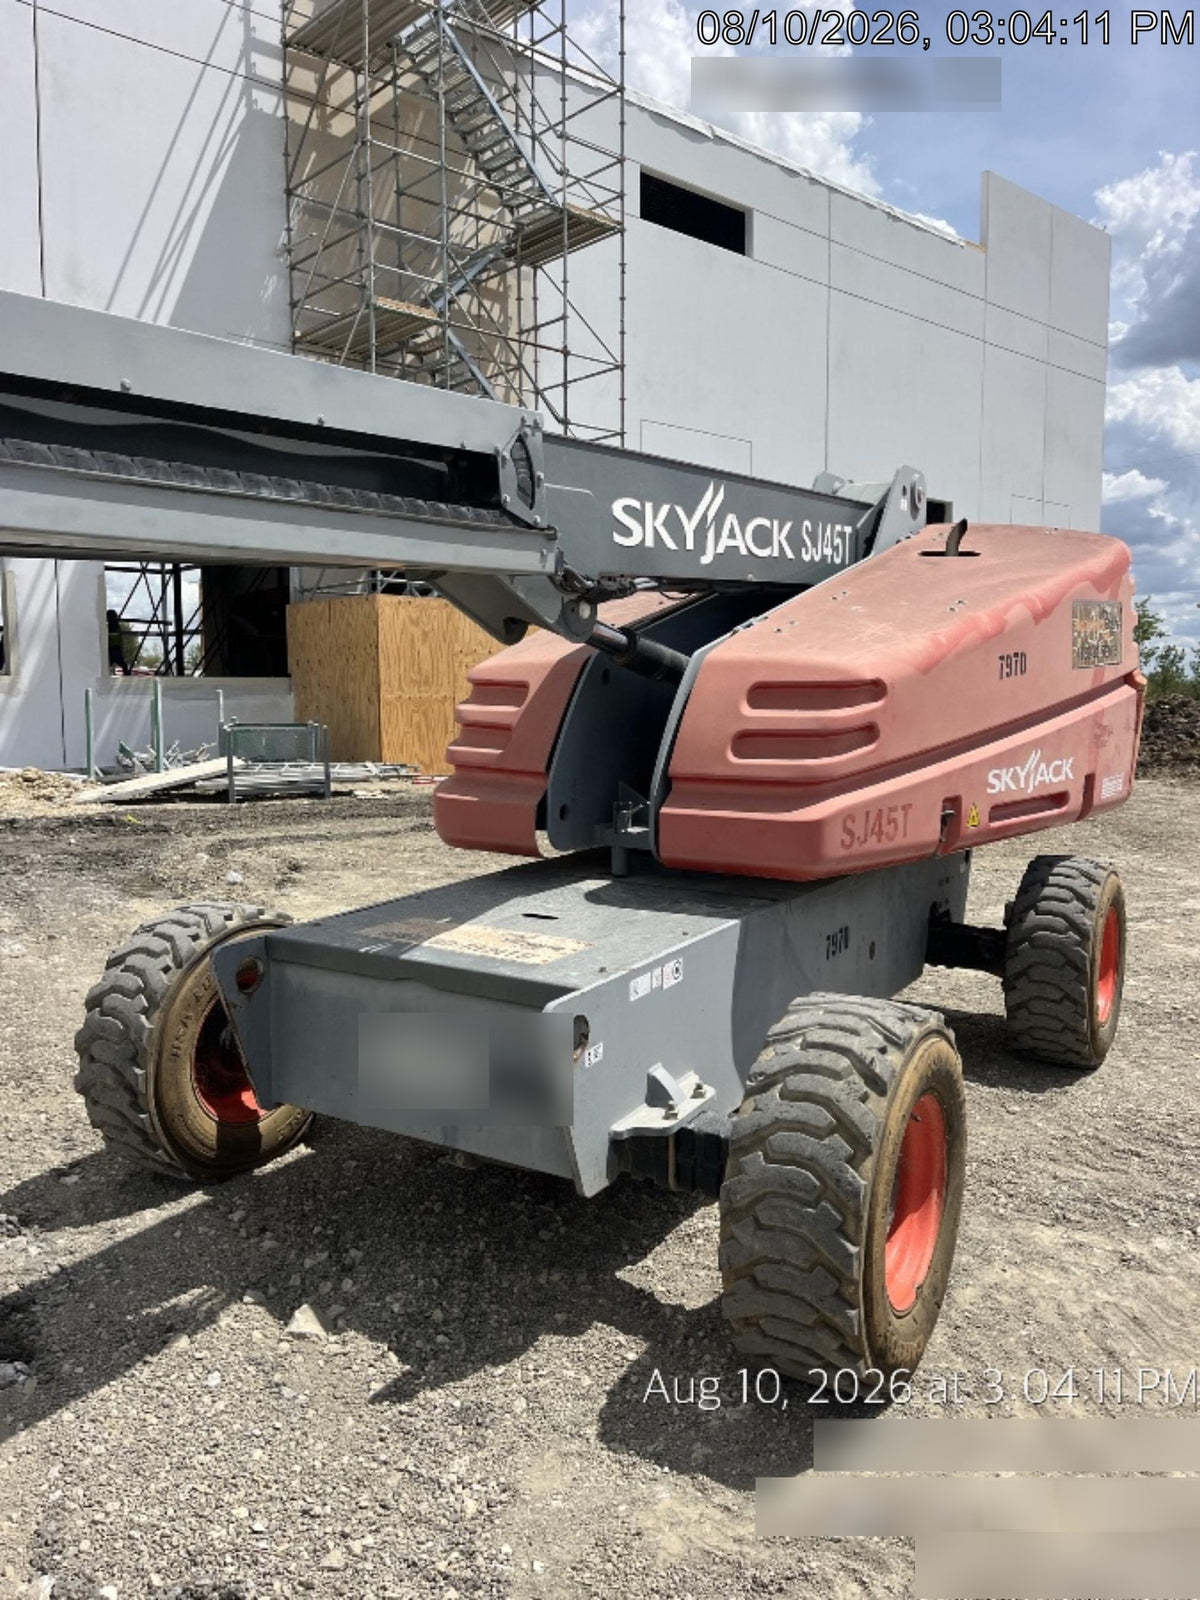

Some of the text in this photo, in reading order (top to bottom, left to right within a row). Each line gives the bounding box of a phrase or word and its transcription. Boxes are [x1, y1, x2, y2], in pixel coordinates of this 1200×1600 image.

[611, 480, 853, 565] SKYJACK SJ45T
[986, 749, 1074, 794] SKYJACK
[840, 803, 913, 850] SJ45T
